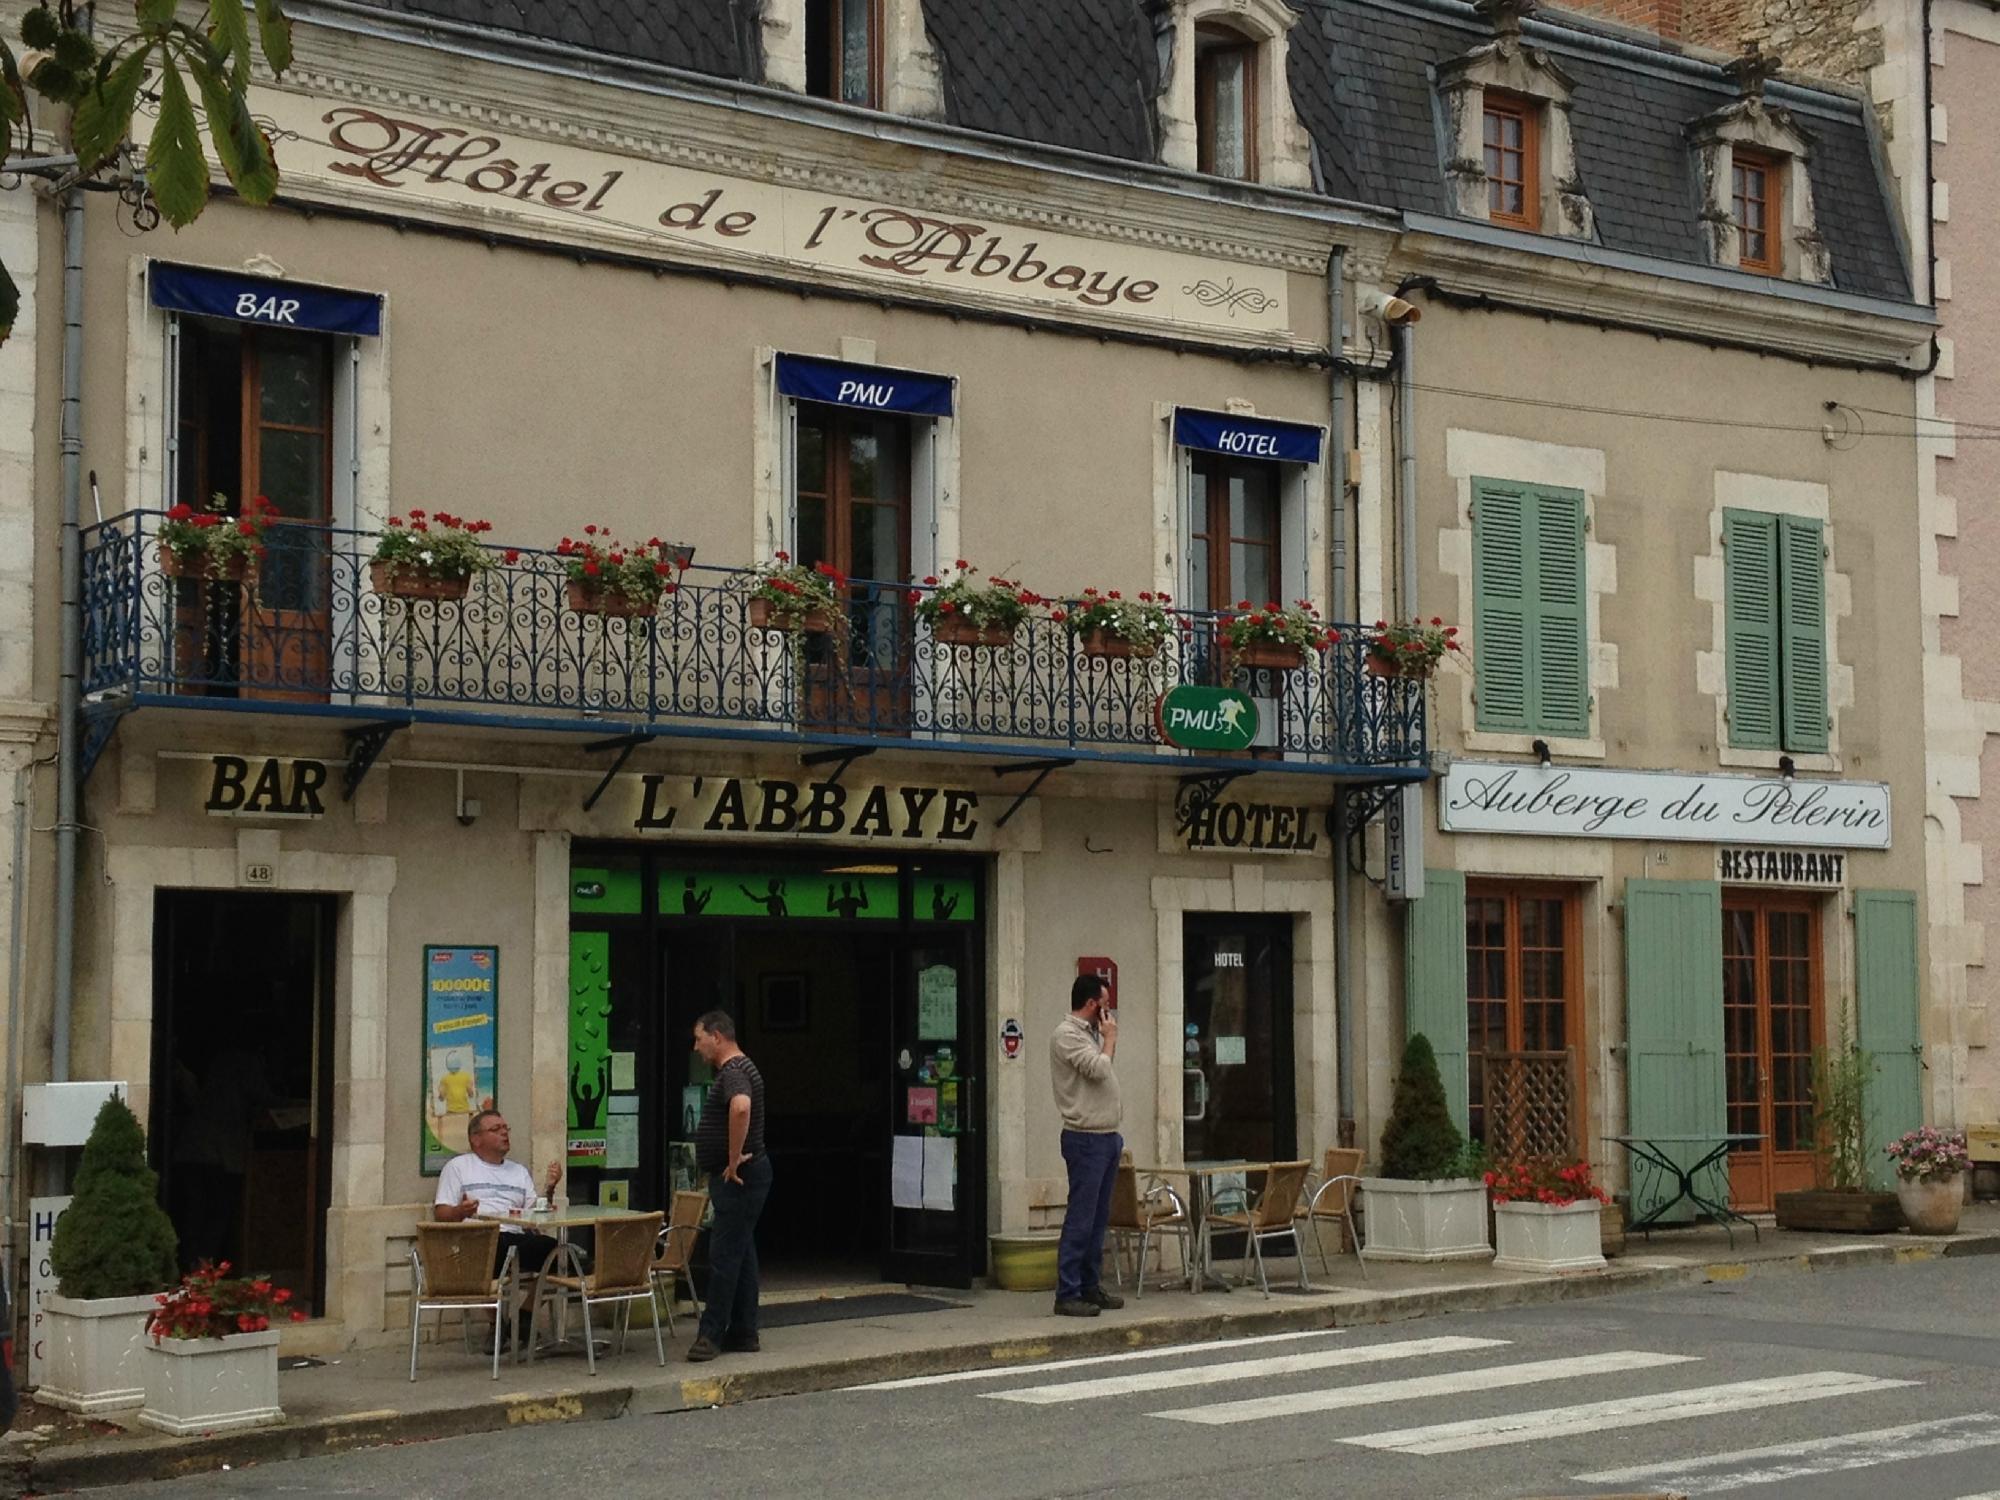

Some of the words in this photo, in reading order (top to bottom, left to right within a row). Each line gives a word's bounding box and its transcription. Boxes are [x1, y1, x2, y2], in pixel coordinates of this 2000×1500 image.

[321, 107, 624, 211] Hôtel
[657, 190, 756, 237] de
[804, 206, 1159, 304] l'Abbaye
[235, 293, 300, 324] BAR
[838, 380, 893, 407] PMU
[1218, 428, 1280, 456] HOTEL
[1170, 707, 1217, 732] PMU
[205, 755, 328, 814] BAR
[1449, 770, 1648, 832] Auberge
[1661, 783, 1719, 823] du
[634, 775, 980, 840] L'ABBAYE
[1188, 801, 1318, 850] HOTEL
[1388, 794, 1401, 891] HOTEL
[249, 867, 269, 880] 48
[1721, 849, 1844, 882] RESTAURANT
[1214, 953, 1244, 968] HOTEL
